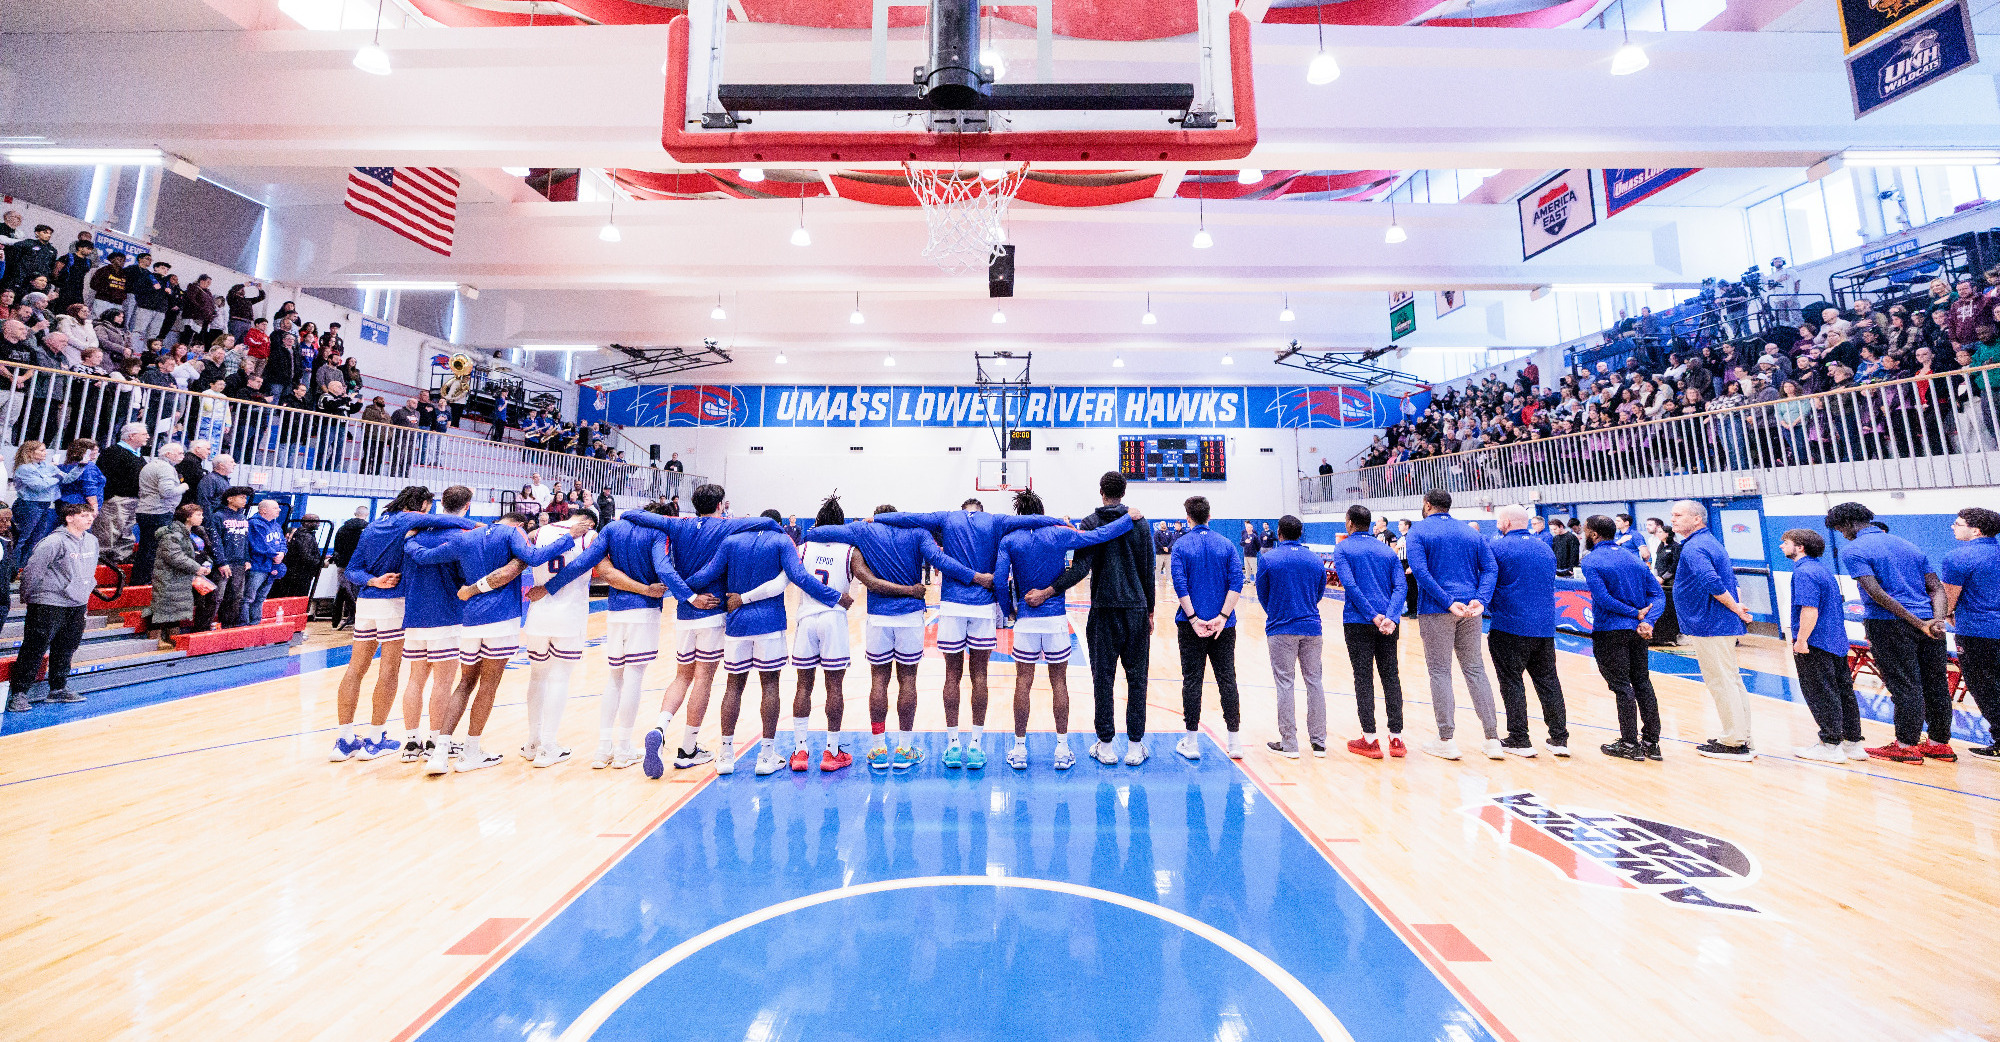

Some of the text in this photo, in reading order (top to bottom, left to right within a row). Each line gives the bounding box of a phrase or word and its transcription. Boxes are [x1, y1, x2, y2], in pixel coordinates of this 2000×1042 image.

[1884, 45, 1938, 84] UNH
[1885, 58, 1940, 94] WILDCATS
[1533, 190, 1578, 225] AMERICA
[1542, 206, 1568, 228] EAST
[97, 236, 124, 250] UPPER
[371, 330, 378, 342] 2
[776, 392, 1239, 421] UMASS LOWELL RIVER HAWKS
[1492, 792, 1762, 913] AMERICA
[1565, 812, 1733, 878] EAST
